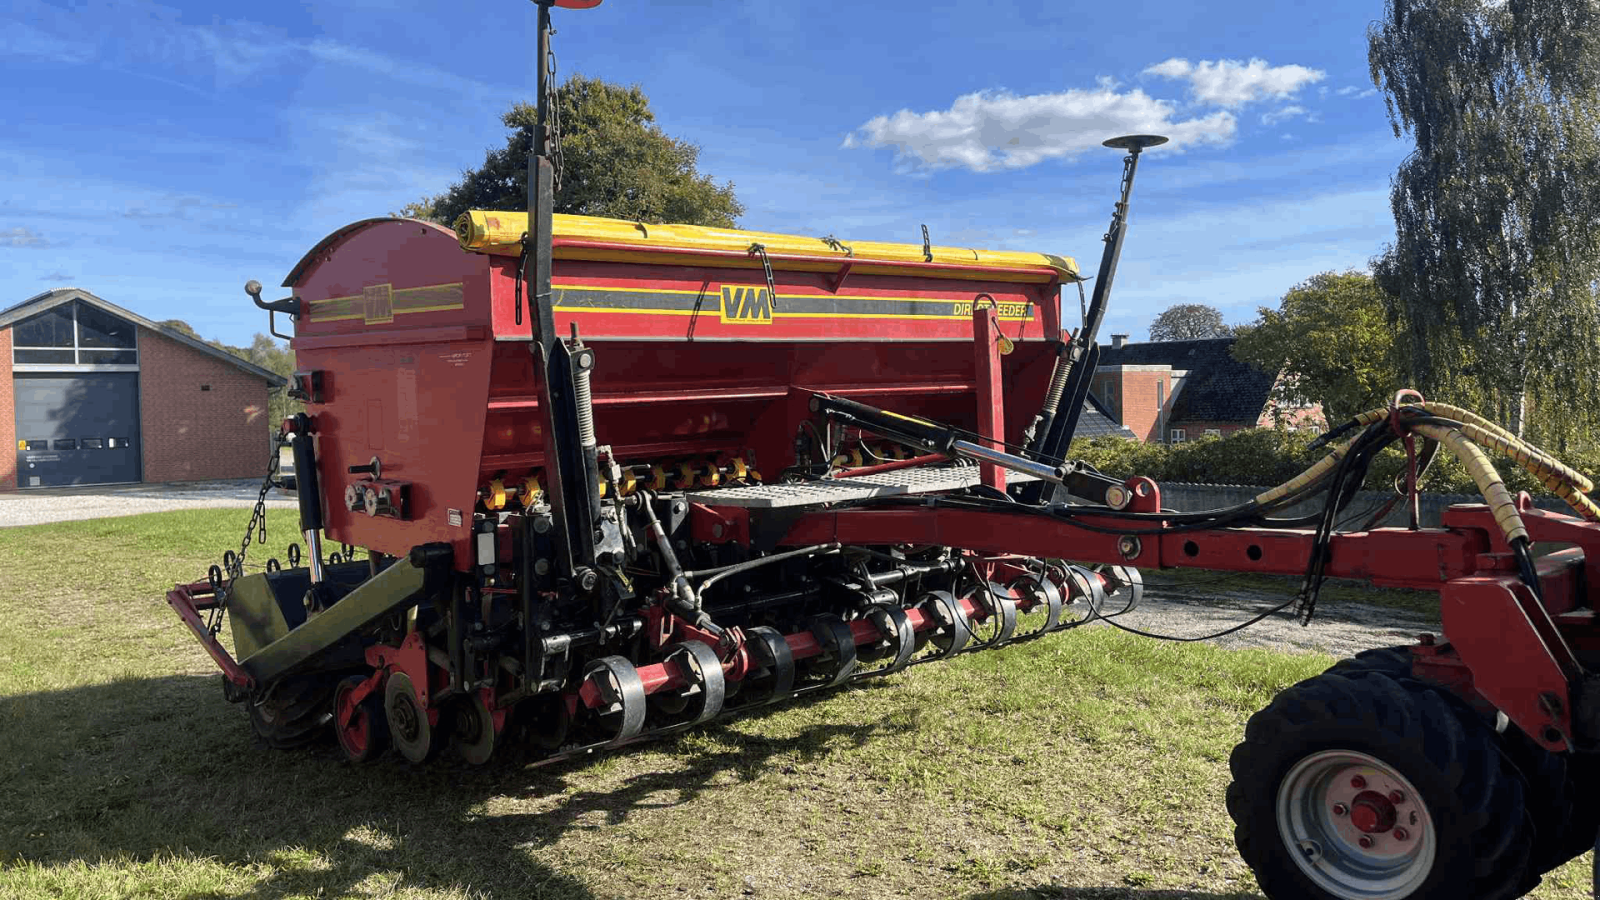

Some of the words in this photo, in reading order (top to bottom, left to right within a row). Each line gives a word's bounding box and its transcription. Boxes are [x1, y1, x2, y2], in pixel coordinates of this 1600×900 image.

[722, 287, 771, 319] VM
[953, 303, 990, 316] DIRCT
[991, 304, 1027, 317] EEDER
